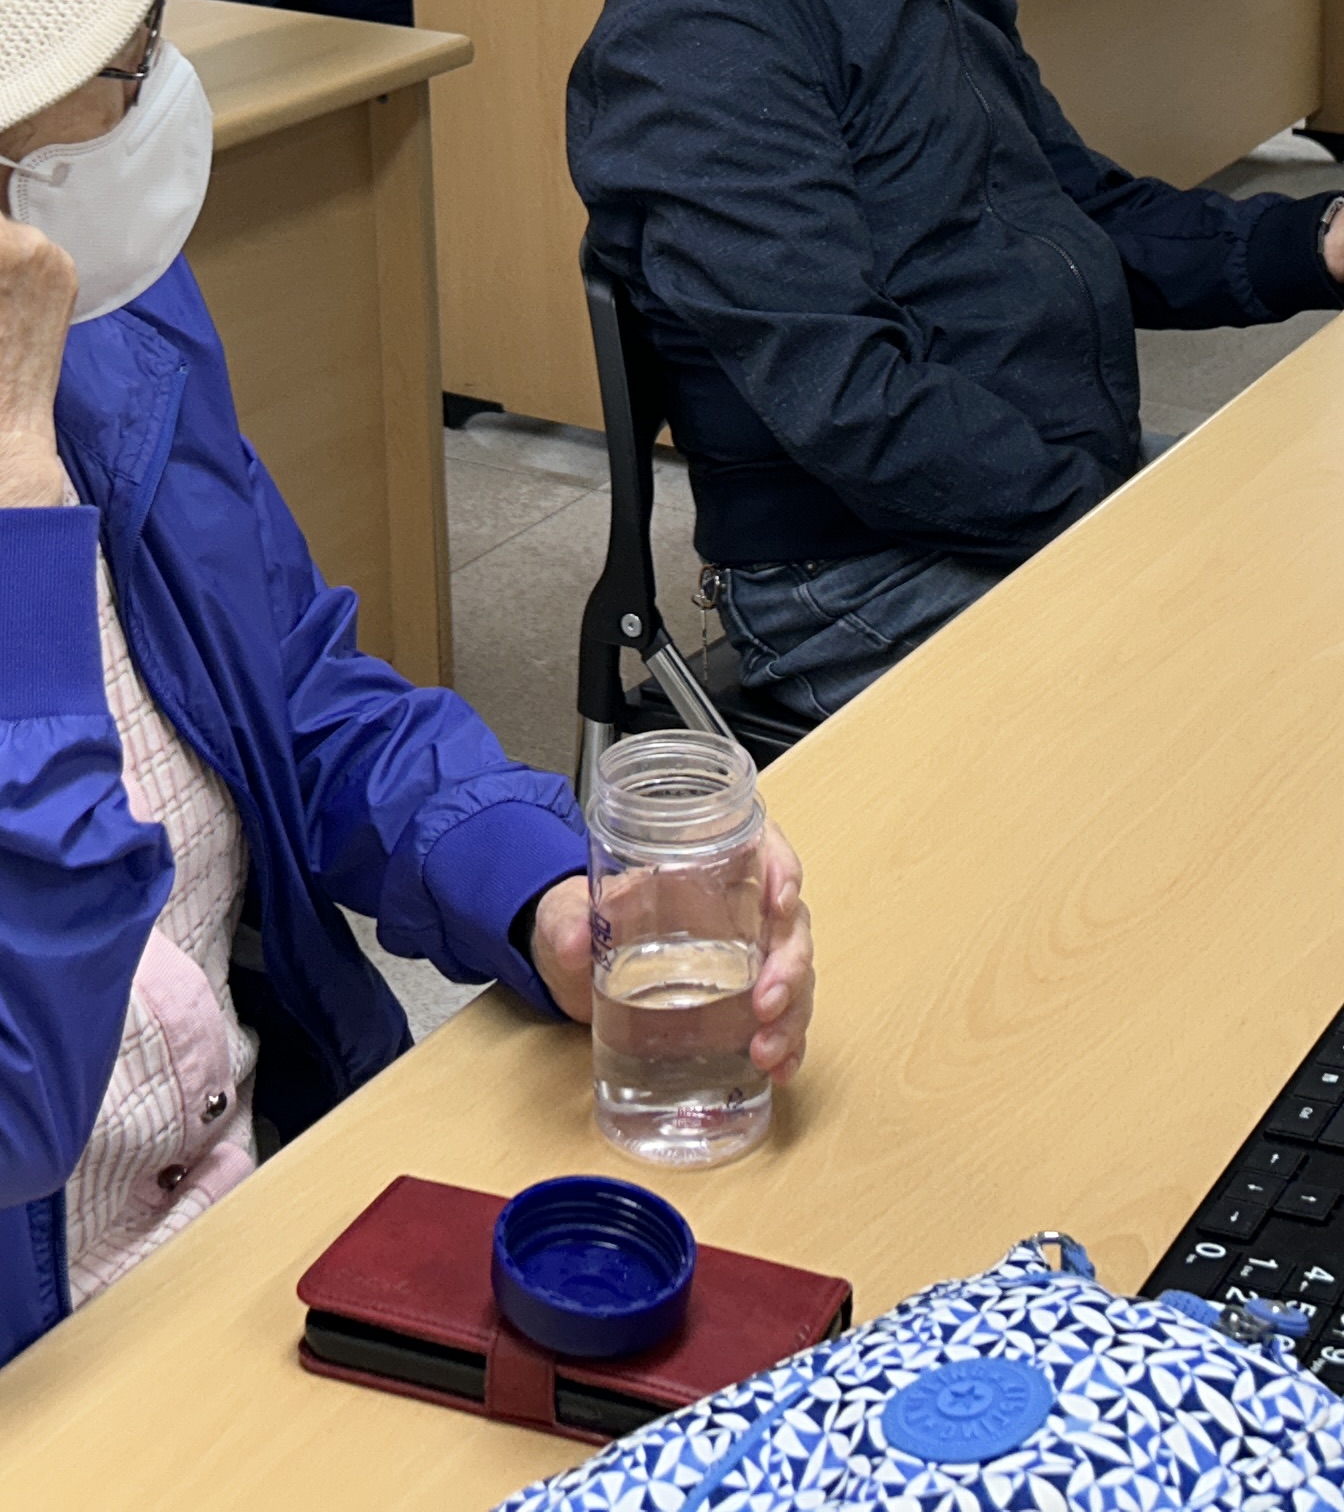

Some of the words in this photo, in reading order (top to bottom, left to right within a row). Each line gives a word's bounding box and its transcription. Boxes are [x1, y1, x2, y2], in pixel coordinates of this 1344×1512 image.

[1196, 1243, 1226, 1257] 0
[1249, 1258, 1278, 1268] 1
[1304, 1267, 1334, 1282] 4
